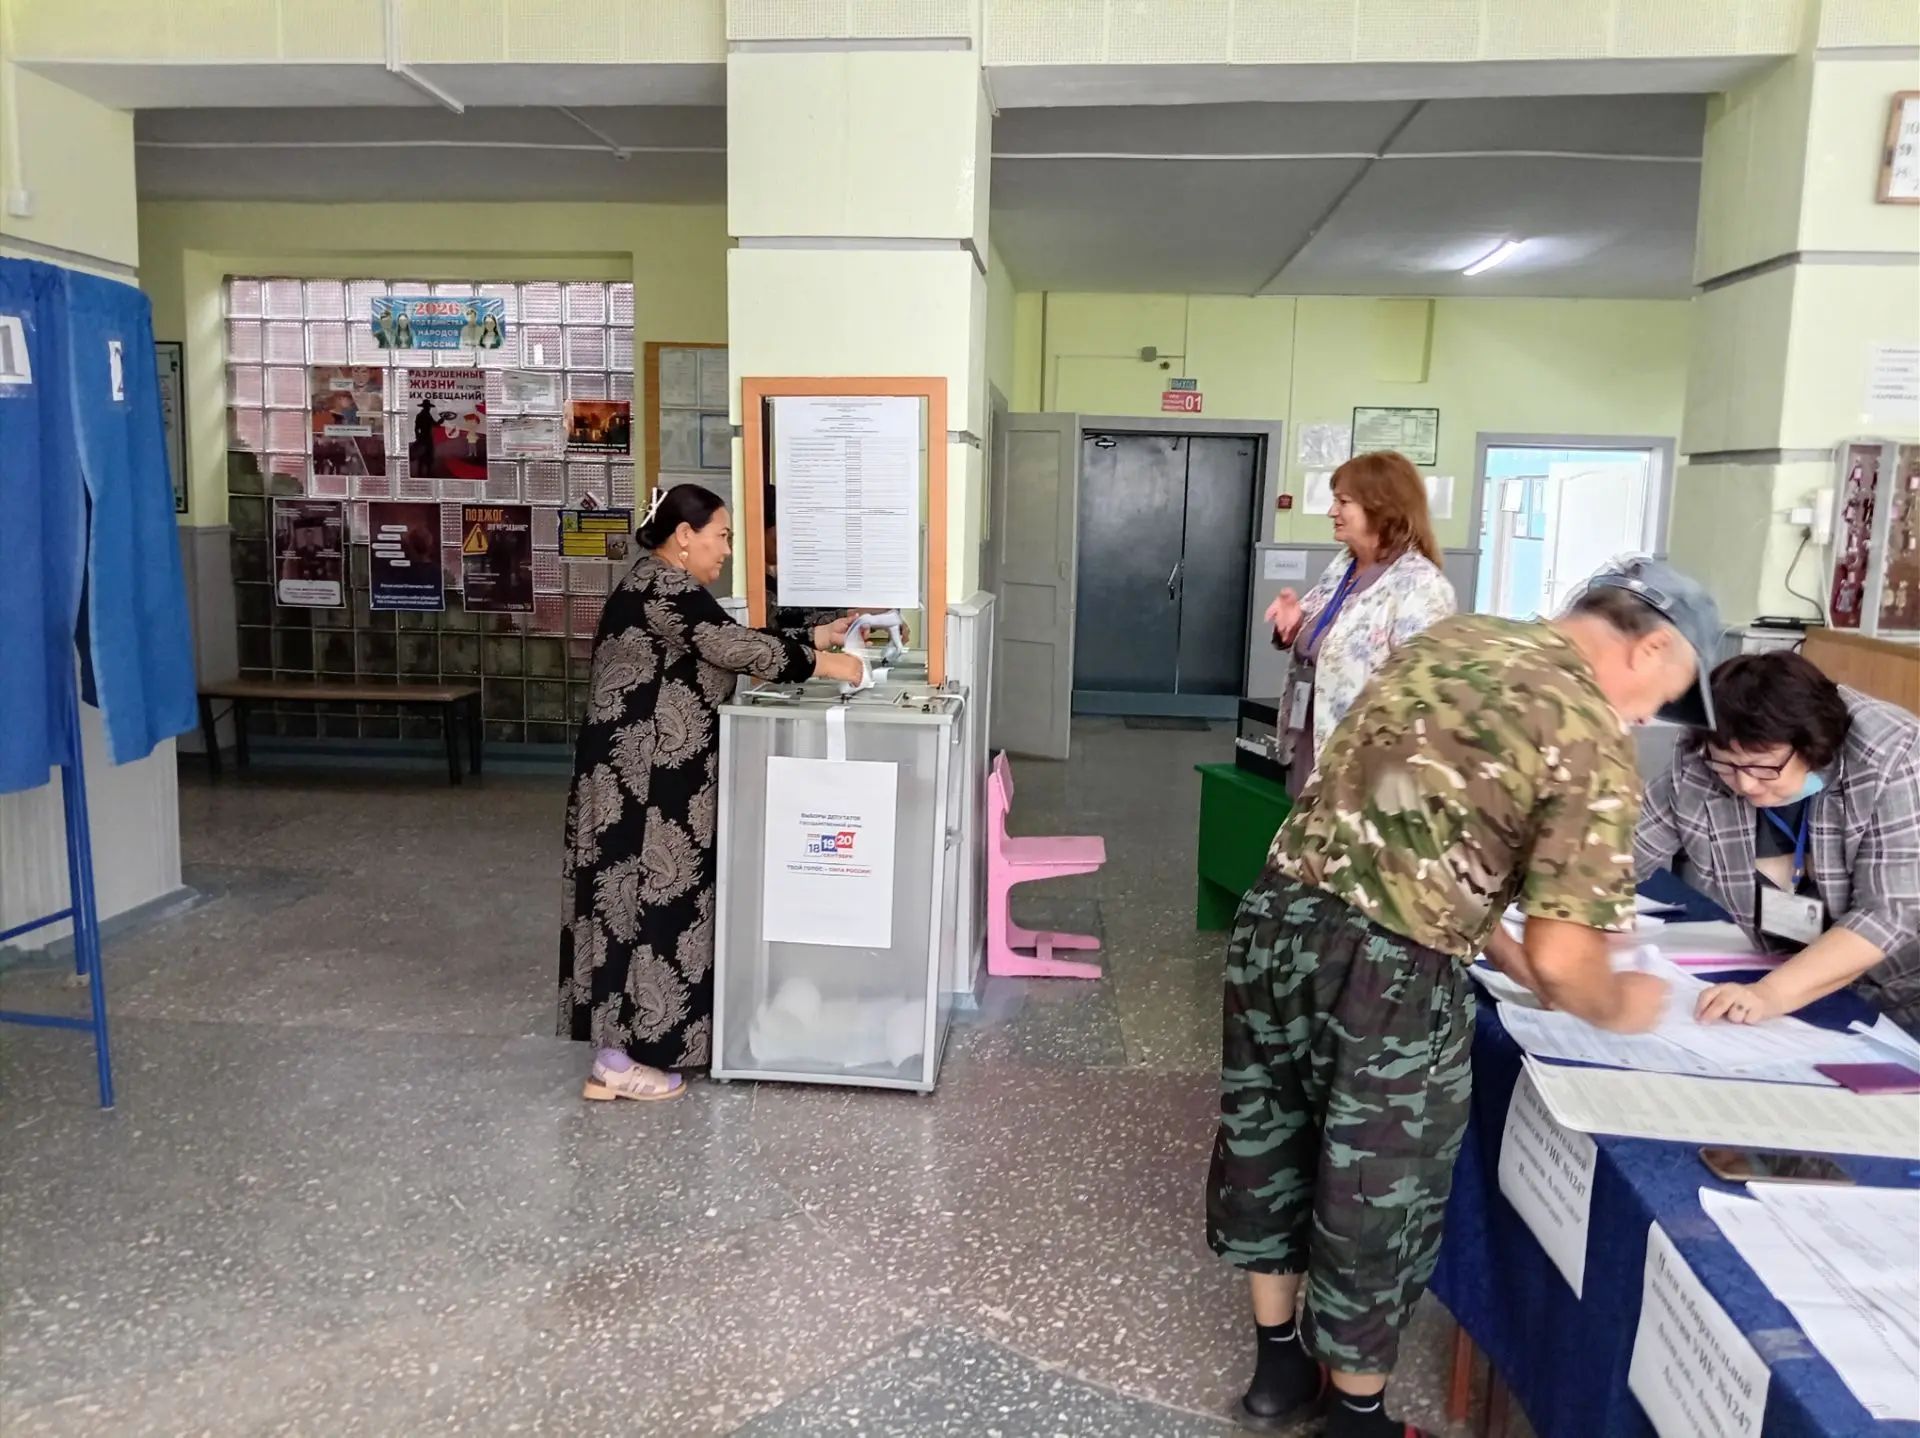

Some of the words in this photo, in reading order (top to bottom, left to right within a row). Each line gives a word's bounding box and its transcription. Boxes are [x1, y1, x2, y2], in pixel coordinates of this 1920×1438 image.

[415, 302, 460, 316] 2026
[417, 329, 459, 338] НАРОДОВ
[420, 340, 457, 348] РОССИИ
[408, 370, 485, 379] РАЗРУШЕННЫЕ
[410, 379, 455, 389] ЖИЗНИ
[409, 392, 422, 400] ИХ
[425, 391, 485, 401] ОБЕЩАНИЙ!
[1185, 395, 1201, 411] 01
[465, 508, 504, 522] ПОДЖОГ
[808, 844, 820, 853] 18
[823, 838, 835, 849] 19
[837, 835, 851, 845] 20
[1544, 1138, 1561, 1169] УИК
[1692, 1337, 1714, 1383] УИК
